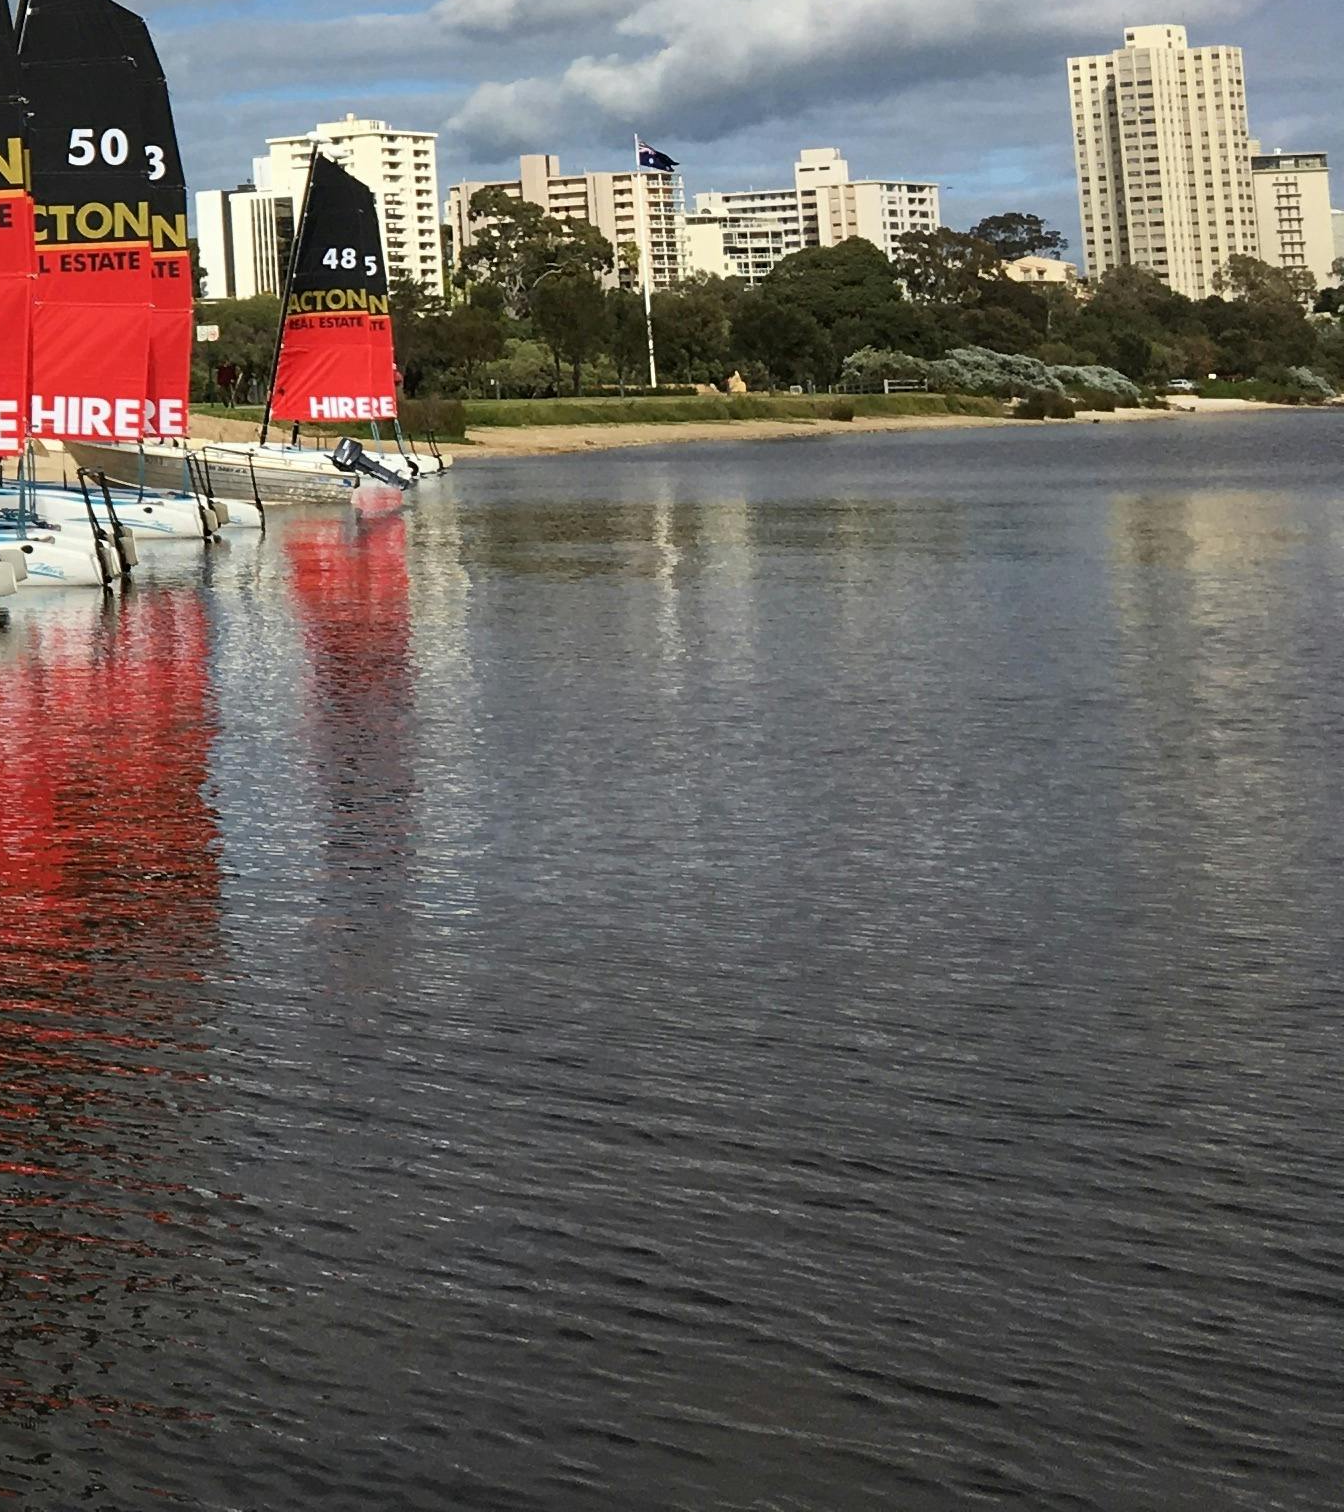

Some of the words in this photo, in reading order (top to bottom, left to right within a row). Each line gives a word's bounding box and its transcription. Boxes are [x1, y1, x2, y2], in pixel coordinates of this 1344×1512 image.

[68, 128, 128, 166] 50
[60, 251, 140, 273] ESTATE
[322, 248, 356, 269] 48
[288, 289, 367, 313] ACTON
[319, 316, 363, 328] ESTATE
[31, 395, 140, 437] HIRE
[309, 396, 372, 419] HIRE
